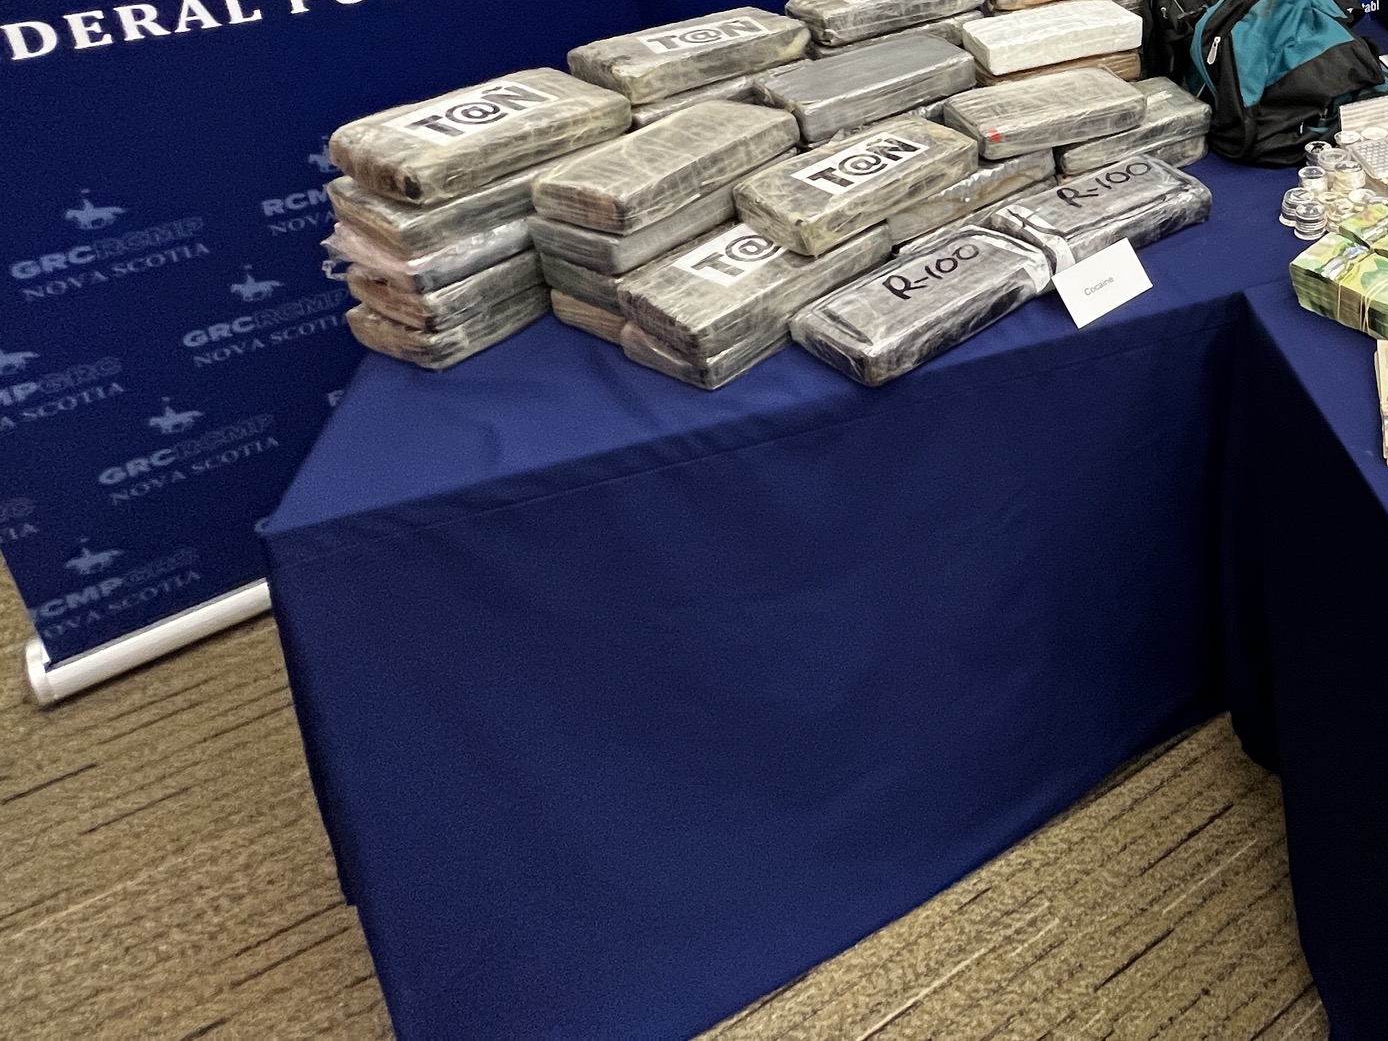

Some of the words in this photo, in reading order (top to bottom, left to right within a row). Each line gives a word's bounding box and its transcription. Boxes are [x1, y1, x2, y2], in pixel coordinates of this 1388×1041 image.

[1057, 162, 1151, 208] R-100
[22, 271, 107, 301] NOVA
[113, 242, 210, 278] SCOTIA
[691, 234, 782, 277] T@
[882, 243, 979, 300] R-100
[1084, 275, 1114, 297] Cocaine
[194, 339, 265, 367] NOVA
